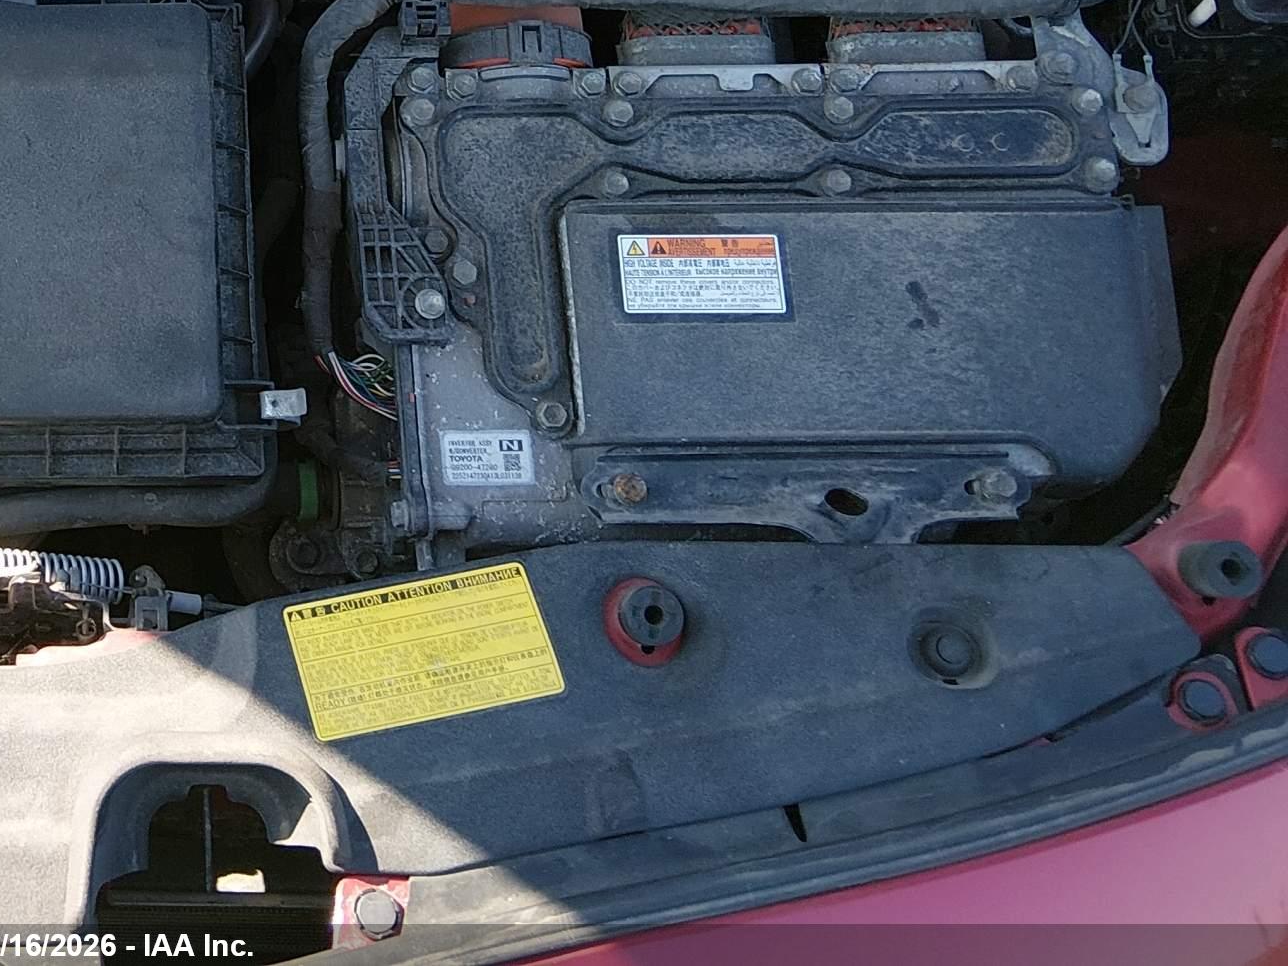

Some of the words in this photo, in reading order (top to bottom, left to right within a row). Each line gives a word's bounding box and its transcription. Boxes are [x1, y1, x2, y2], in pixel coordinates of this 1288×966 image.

[667, 239, 706, 248] WARNING
[502, 440, 519, 451] N
[457, 567, 520, 590] ВНИМАНИЕ
[330, 595, 382, 613] CAUTION
[388, 580, 452, 602] ATTENTION
